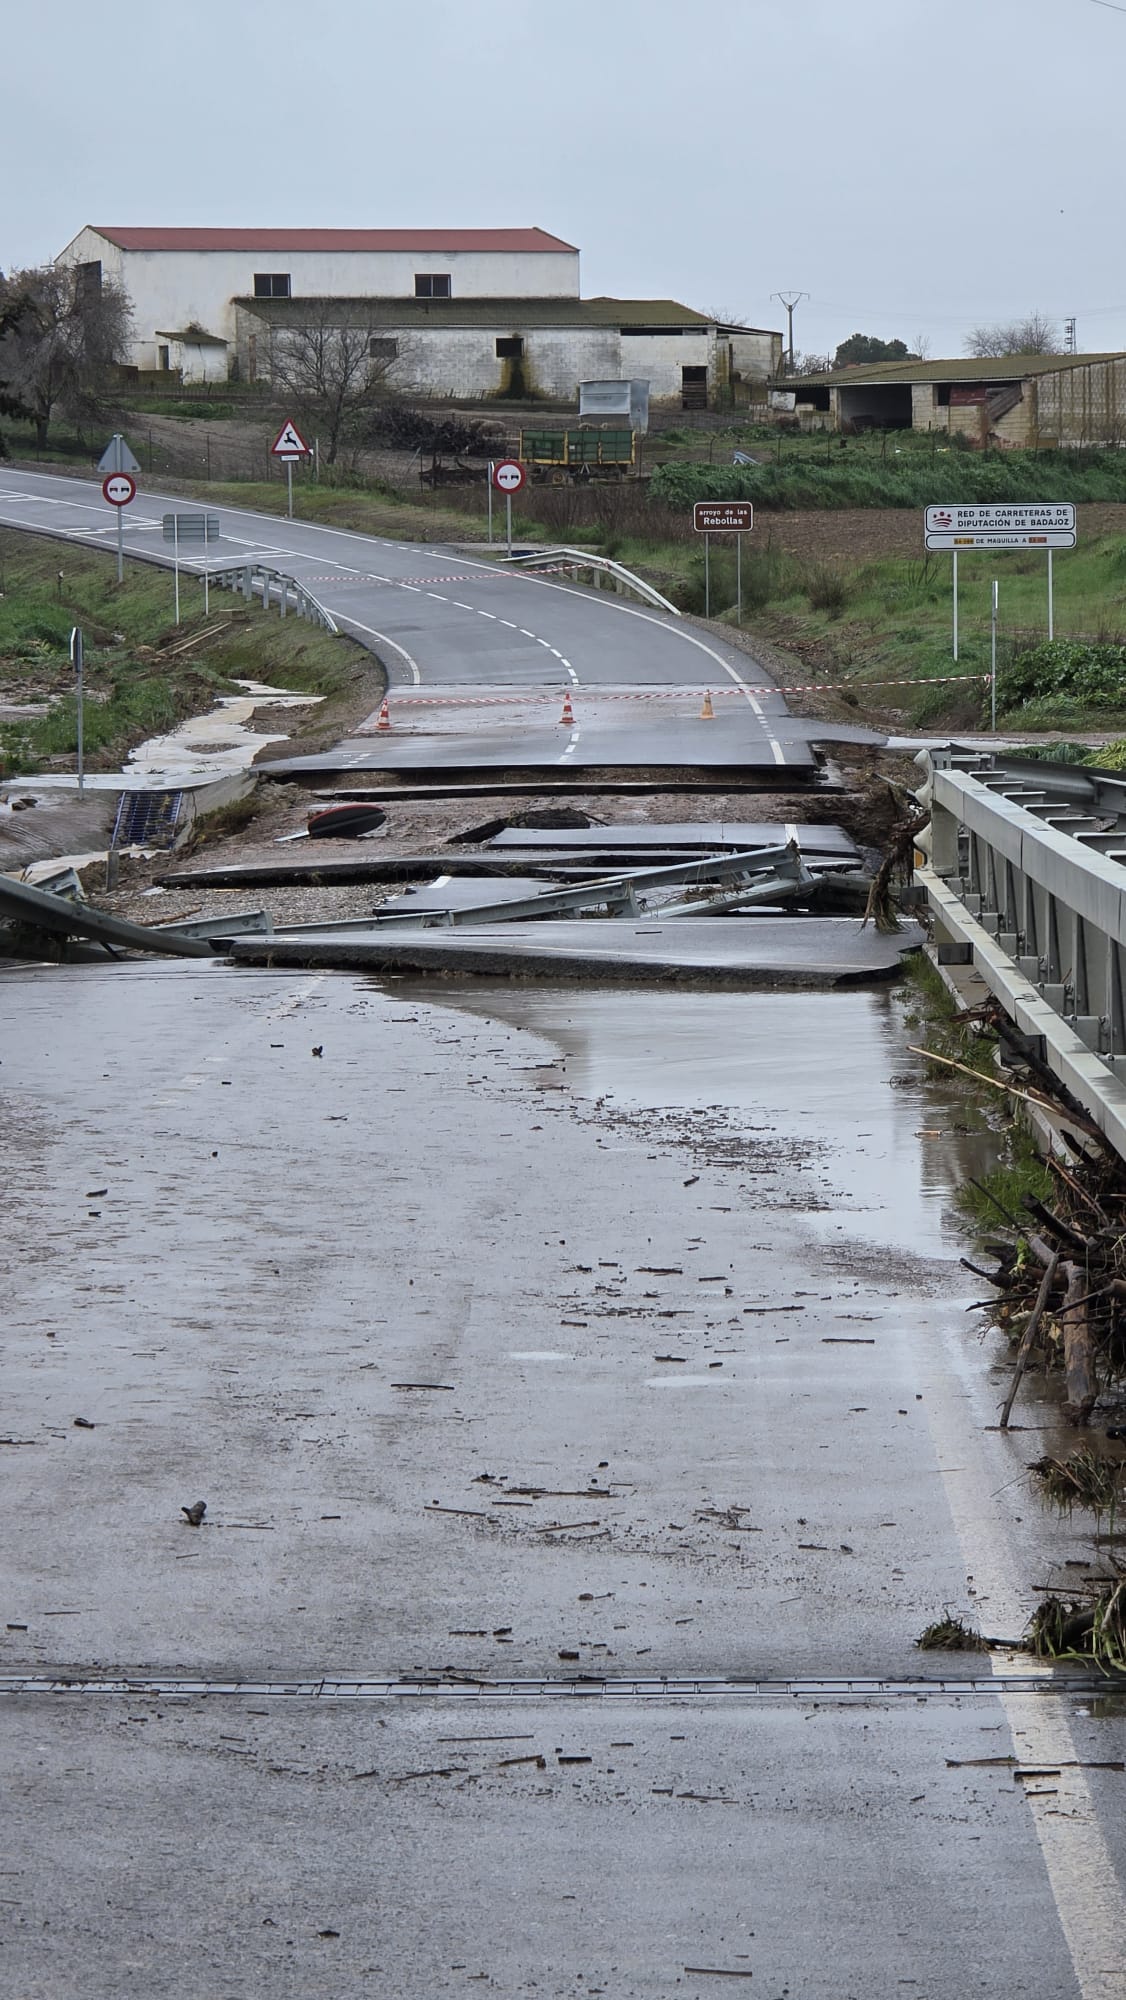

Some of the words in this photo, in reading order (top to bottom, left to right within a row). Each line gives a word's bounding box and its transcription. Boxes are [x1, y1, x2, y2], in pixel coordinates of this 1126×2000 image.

[957, 510, 975, 518] RED
[995, 509, 1052, 517] CARRETERAS
[703, 517, 743, 525] Rebollas
[1030, 518, 1070, 526] BADAJOZ
